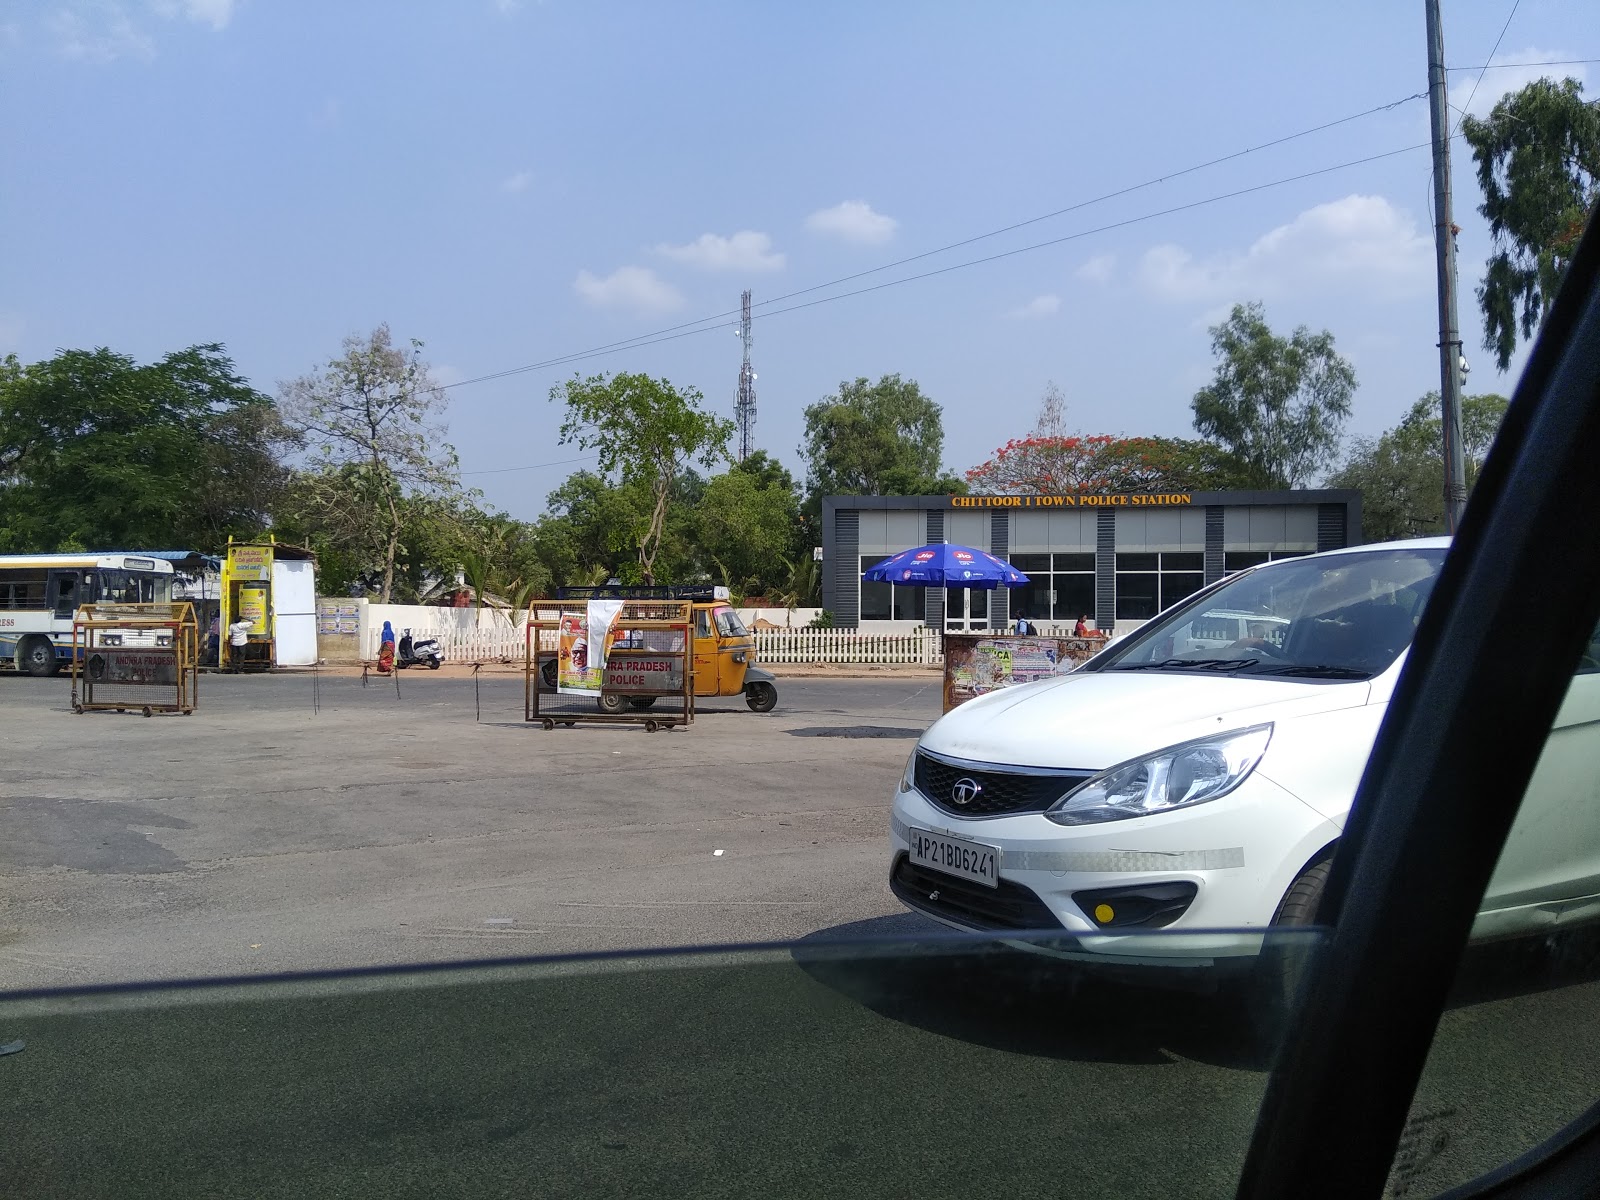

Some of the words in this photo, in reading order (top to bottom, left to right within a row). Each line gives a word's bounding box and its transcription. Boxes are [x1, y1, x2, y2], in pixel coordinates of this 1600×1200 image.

[951, 496, 1022, 507] CHITTOOR
[1034, 495, 1076, 506] TOWN
[1079, 495, 1128, 506] POLICE
[1131, 494, 1192, 505] STATION
[115, 656, 142, 665] ANDHRA
[145, 656, 176, 666] PRADESH
[626, 661, 672, 672] PRADESH
[133, 668, 157, 677] POLICE
[610, 674, 645, 685] POLICE
[917, 836, 995, 879] AP21BD6241
